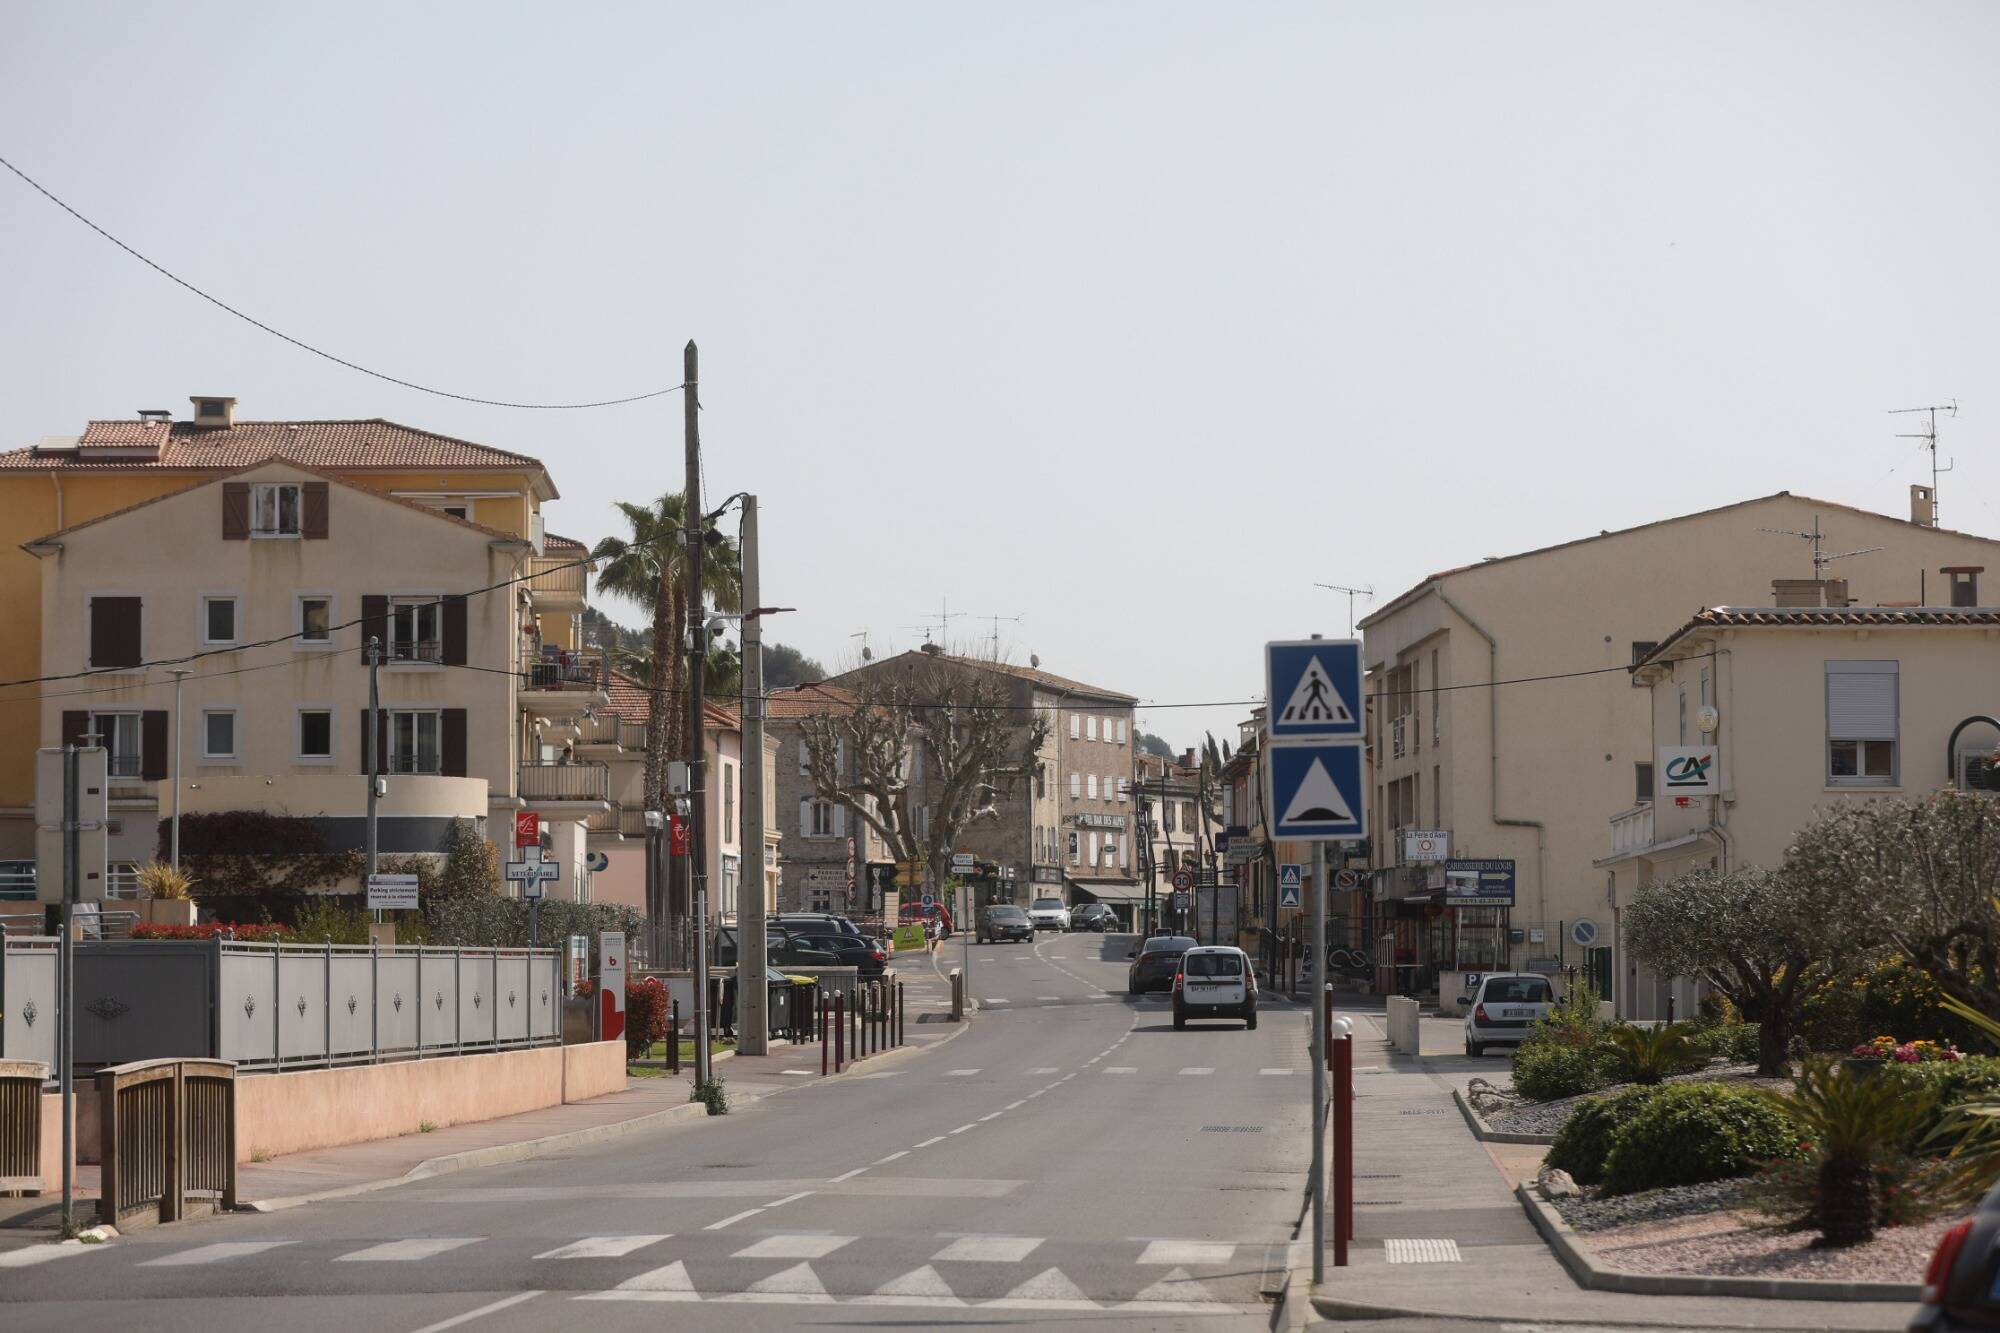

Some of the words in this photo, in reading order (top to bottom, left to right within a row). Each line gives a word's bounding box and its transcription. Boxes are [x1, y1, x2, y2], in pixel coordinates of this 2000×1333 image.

[1094, 815, 1103, 825] BAR
[1104, 816, 1112, 826] DES
[1495, 862, 1512, 870] LOGIS
[1176, 877, 1188, 886] 30
[1469, 975, 1476, 985] P
